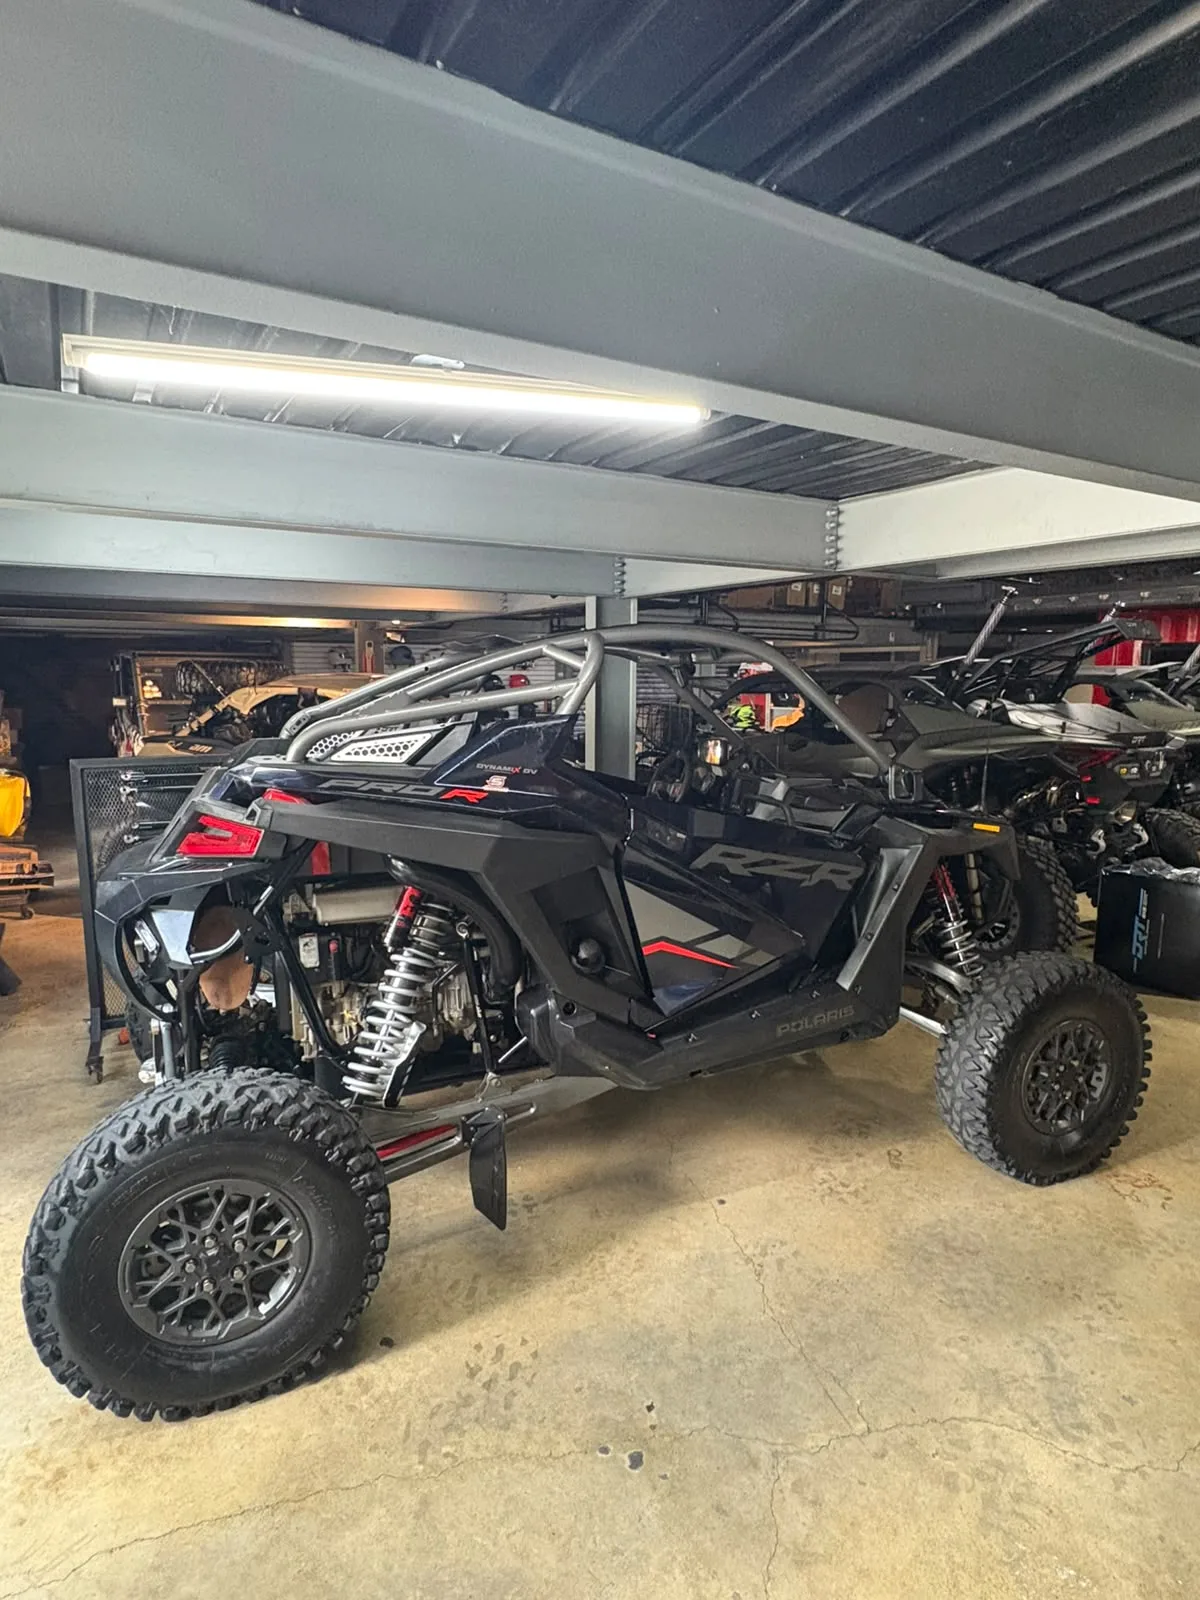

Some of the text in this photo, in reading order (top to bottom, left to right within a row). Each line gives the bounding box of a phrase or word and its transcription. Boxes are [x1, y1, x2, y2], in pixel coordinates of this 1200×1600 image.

[475, 762, 522, 774] DYNAMIX
[318, 779, 446, 797] PRO
[440, 788, 489, 804] R
[689, 843, 865, 891] RZR
[776, 1005, 854, 1037] POLARIS
